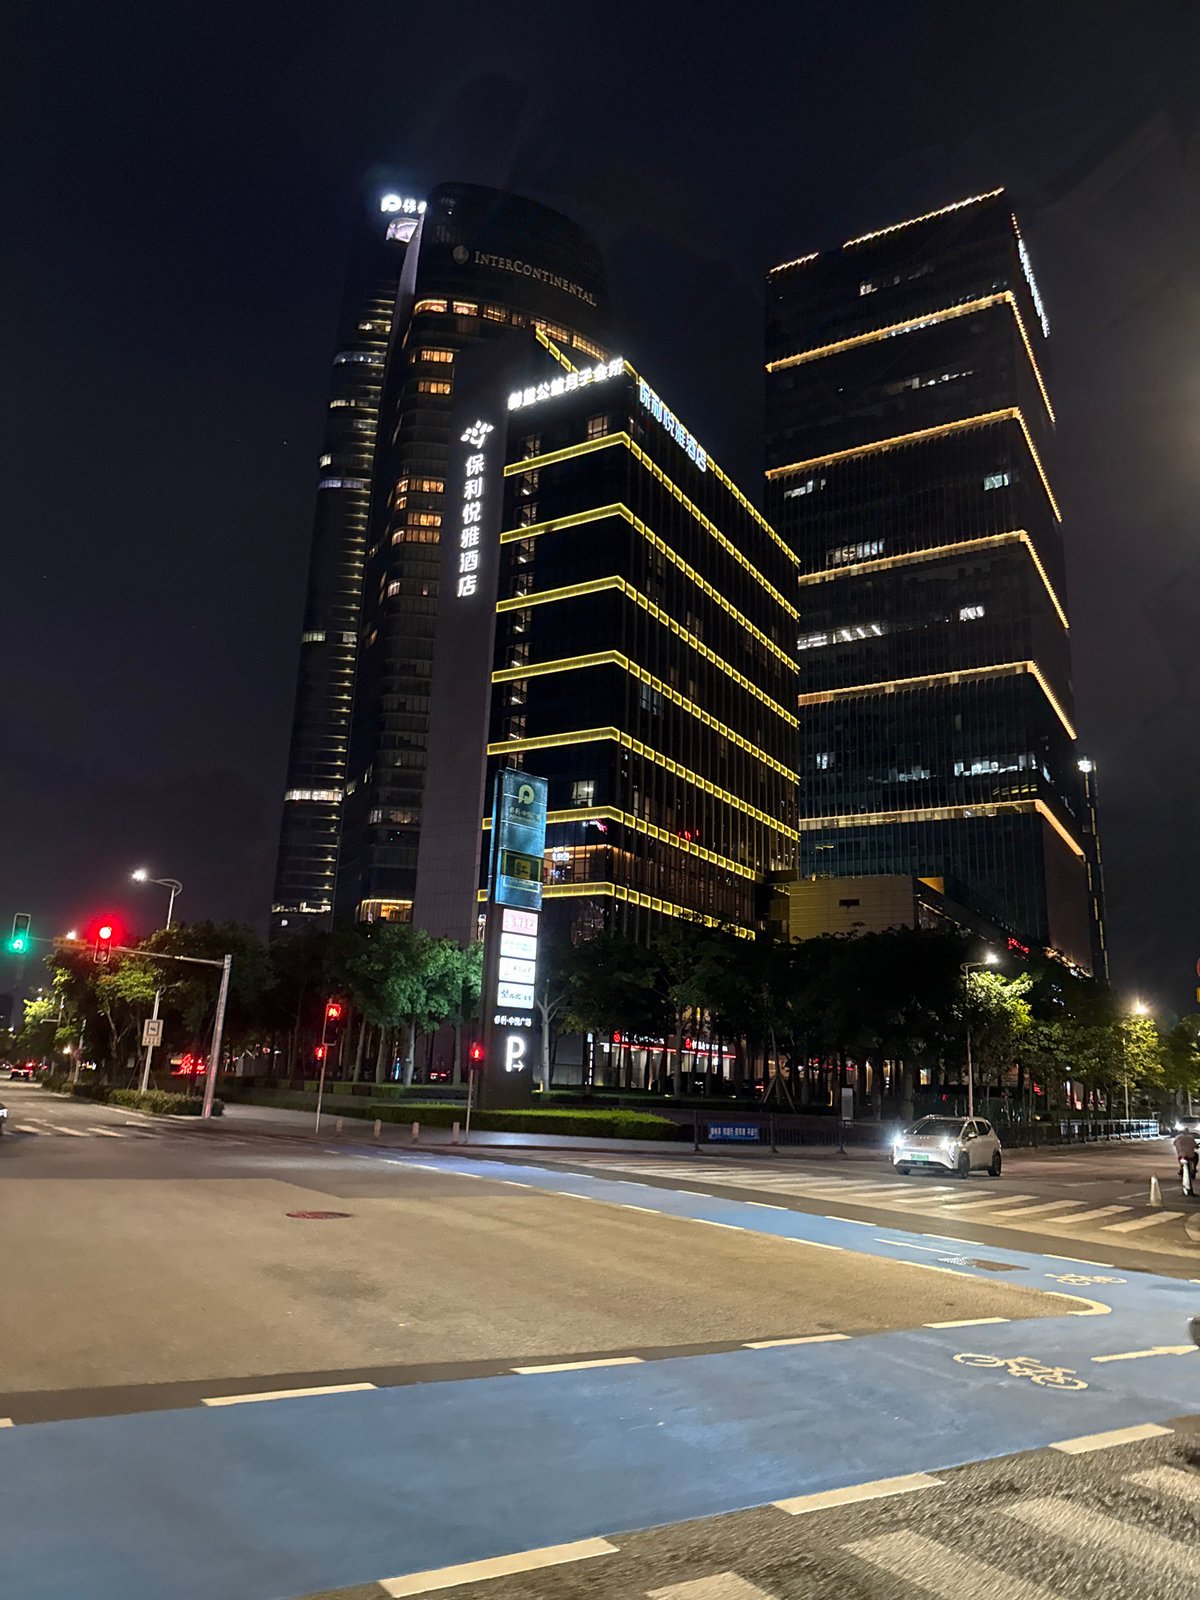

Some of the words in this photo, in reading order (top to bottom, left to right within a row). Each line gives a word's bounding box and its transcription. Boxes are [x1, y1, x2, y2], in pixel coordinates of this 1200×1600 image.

[639, 381, 708, 473] 保利悦雅酒店
[456, 453, 485, 598] 保利悦雅酒店
